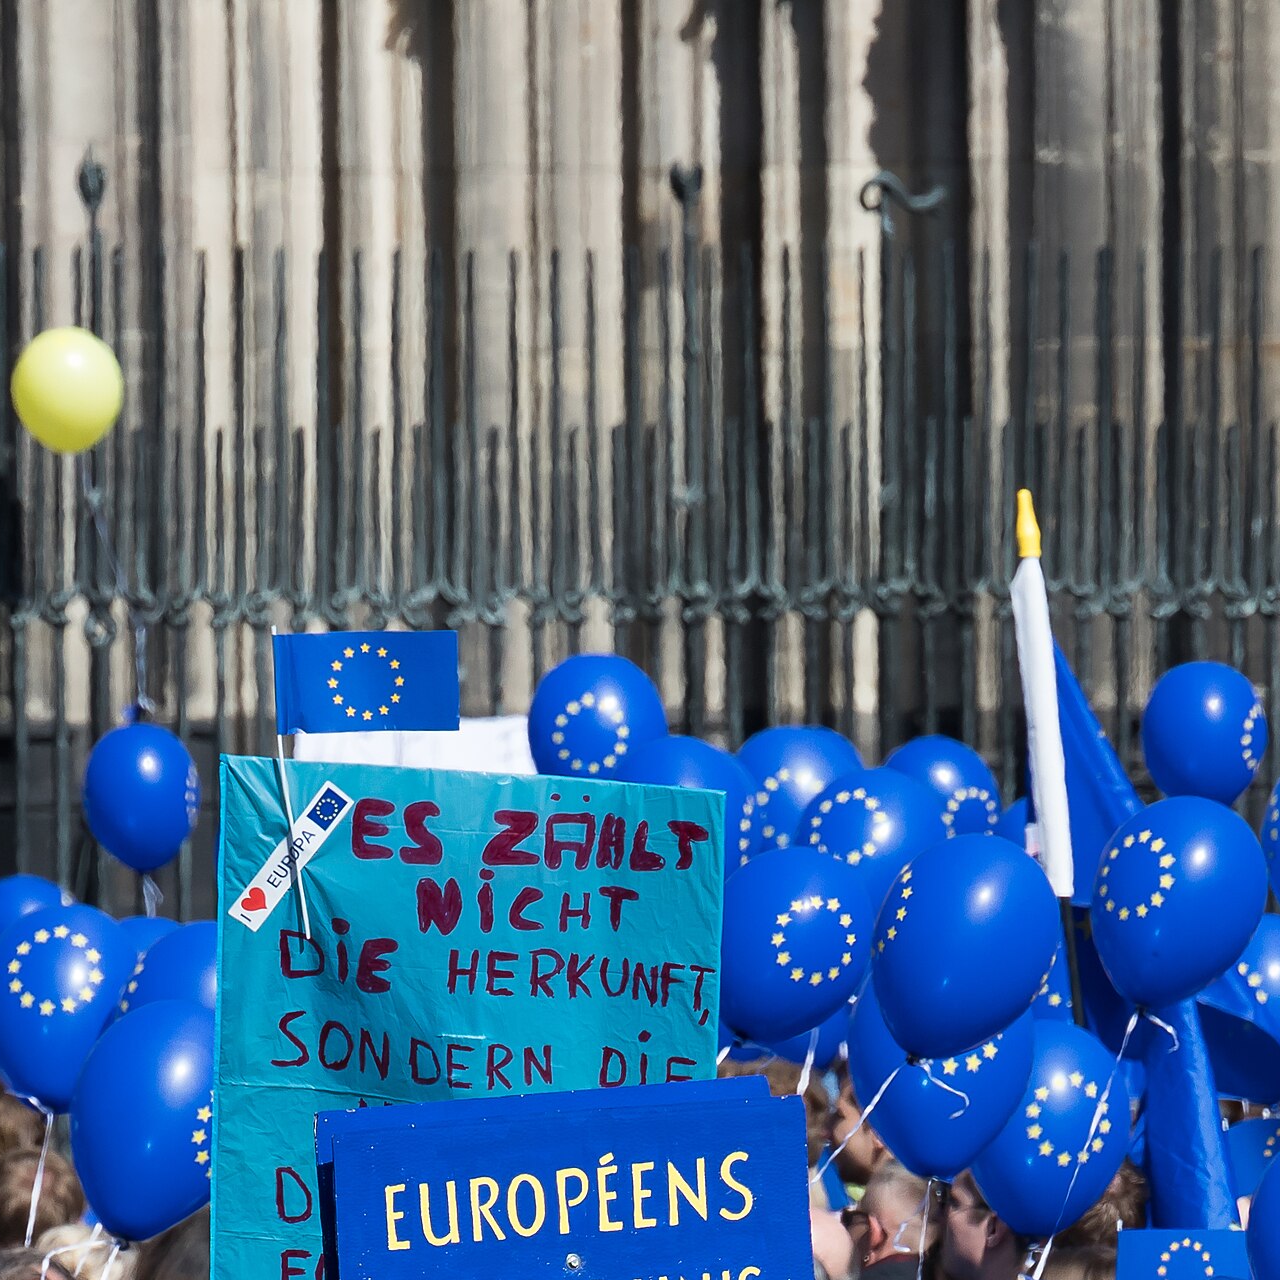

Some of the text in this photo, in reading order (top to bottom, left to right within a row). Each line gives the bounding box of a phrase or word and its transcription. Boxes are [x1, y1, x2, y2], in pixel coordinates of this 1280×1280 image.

[266, 829, 317, 888] EUROPA
[351, 797, 443, 866] ES
[446, 946, 717, 1026] HERKUNFT,
[270, 1010, 554, 1090] SONDERN
[385, 1150, 755, 1251] EUROPÉENS
